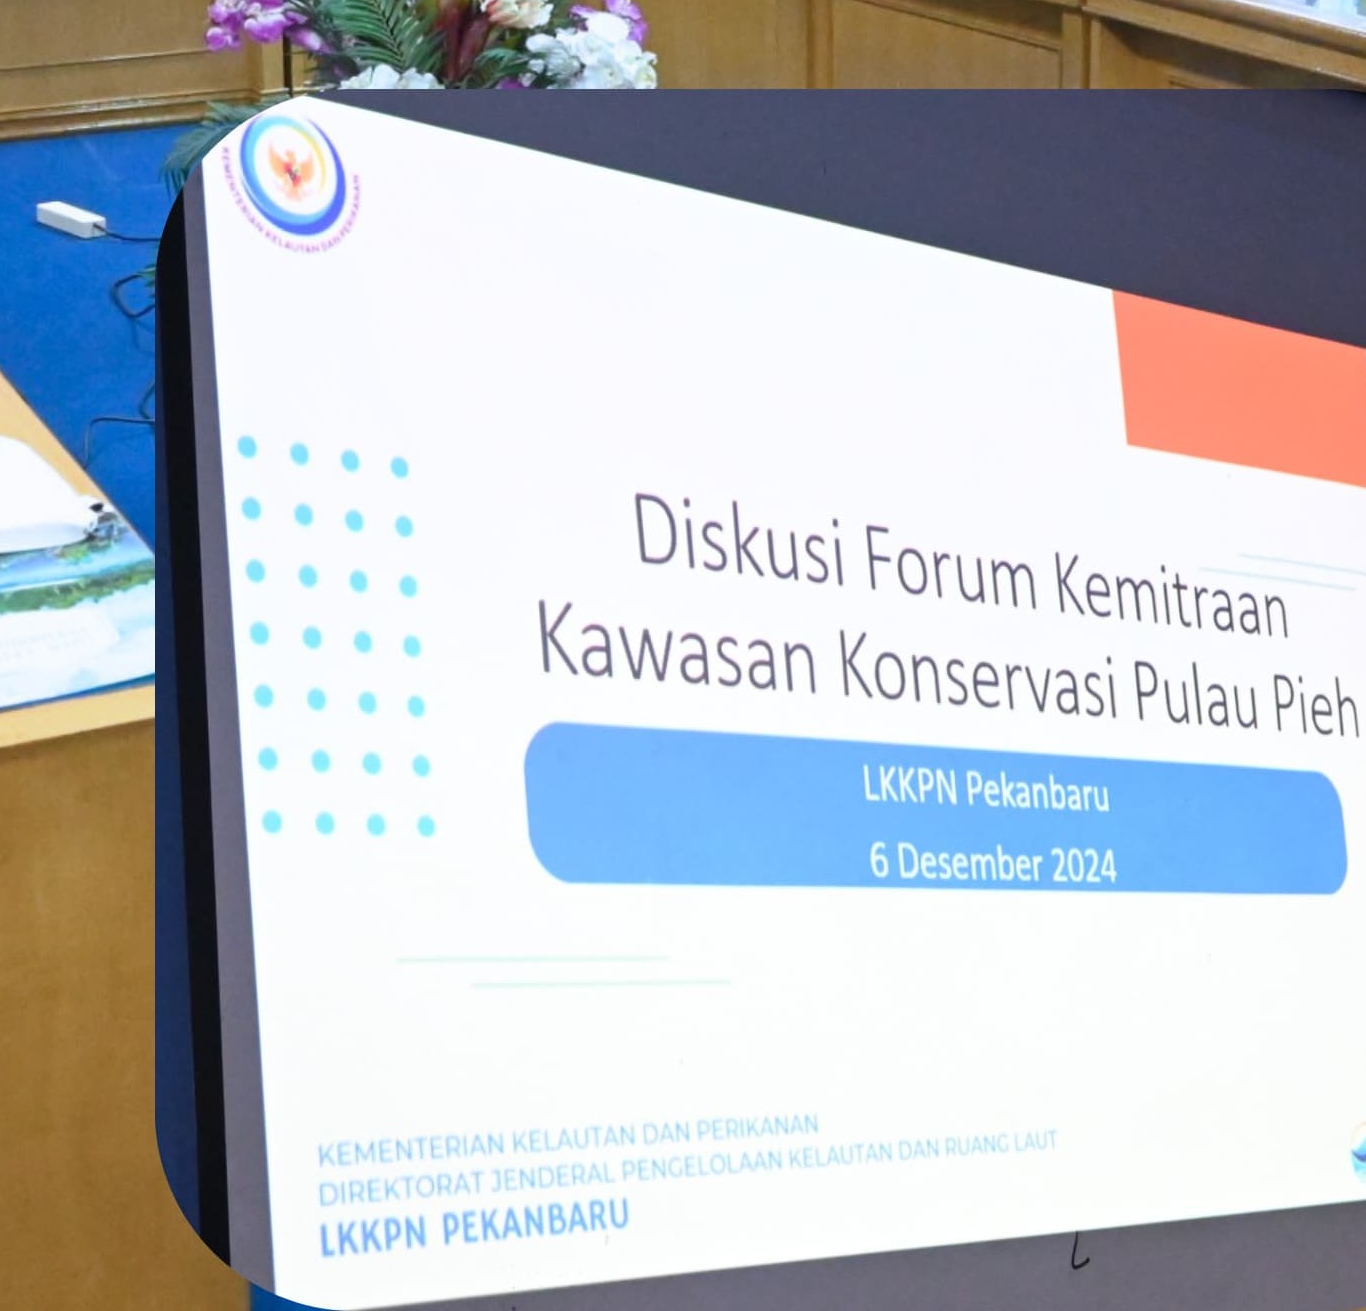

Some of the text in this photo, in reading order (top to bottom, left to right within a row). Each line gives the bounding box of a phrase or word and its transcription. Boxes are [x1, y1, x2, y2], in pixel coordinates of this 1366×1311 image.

[635, 492, 1288, 639] Diskusi Forum Kemitraan
[538, 599, 1360, 738] Kawasan Konservasi Pulau Pieh
[864, 765, 1110, 812] LKKPN Pekanbaru
[870, 842, 1117, 883] 6 Desember 2024
[318, 1114, 820, 1167] KEMENTERIAN KELAUTAN DAN PERIKANAN
[319, 1129, 1058, 1207] DIREKTORAT JENDERAL PENGELOLAAN KELAUTAN DAN RUANG LAUT
[319, 1196, 630, 1259] LKKPN PEKANBARU
